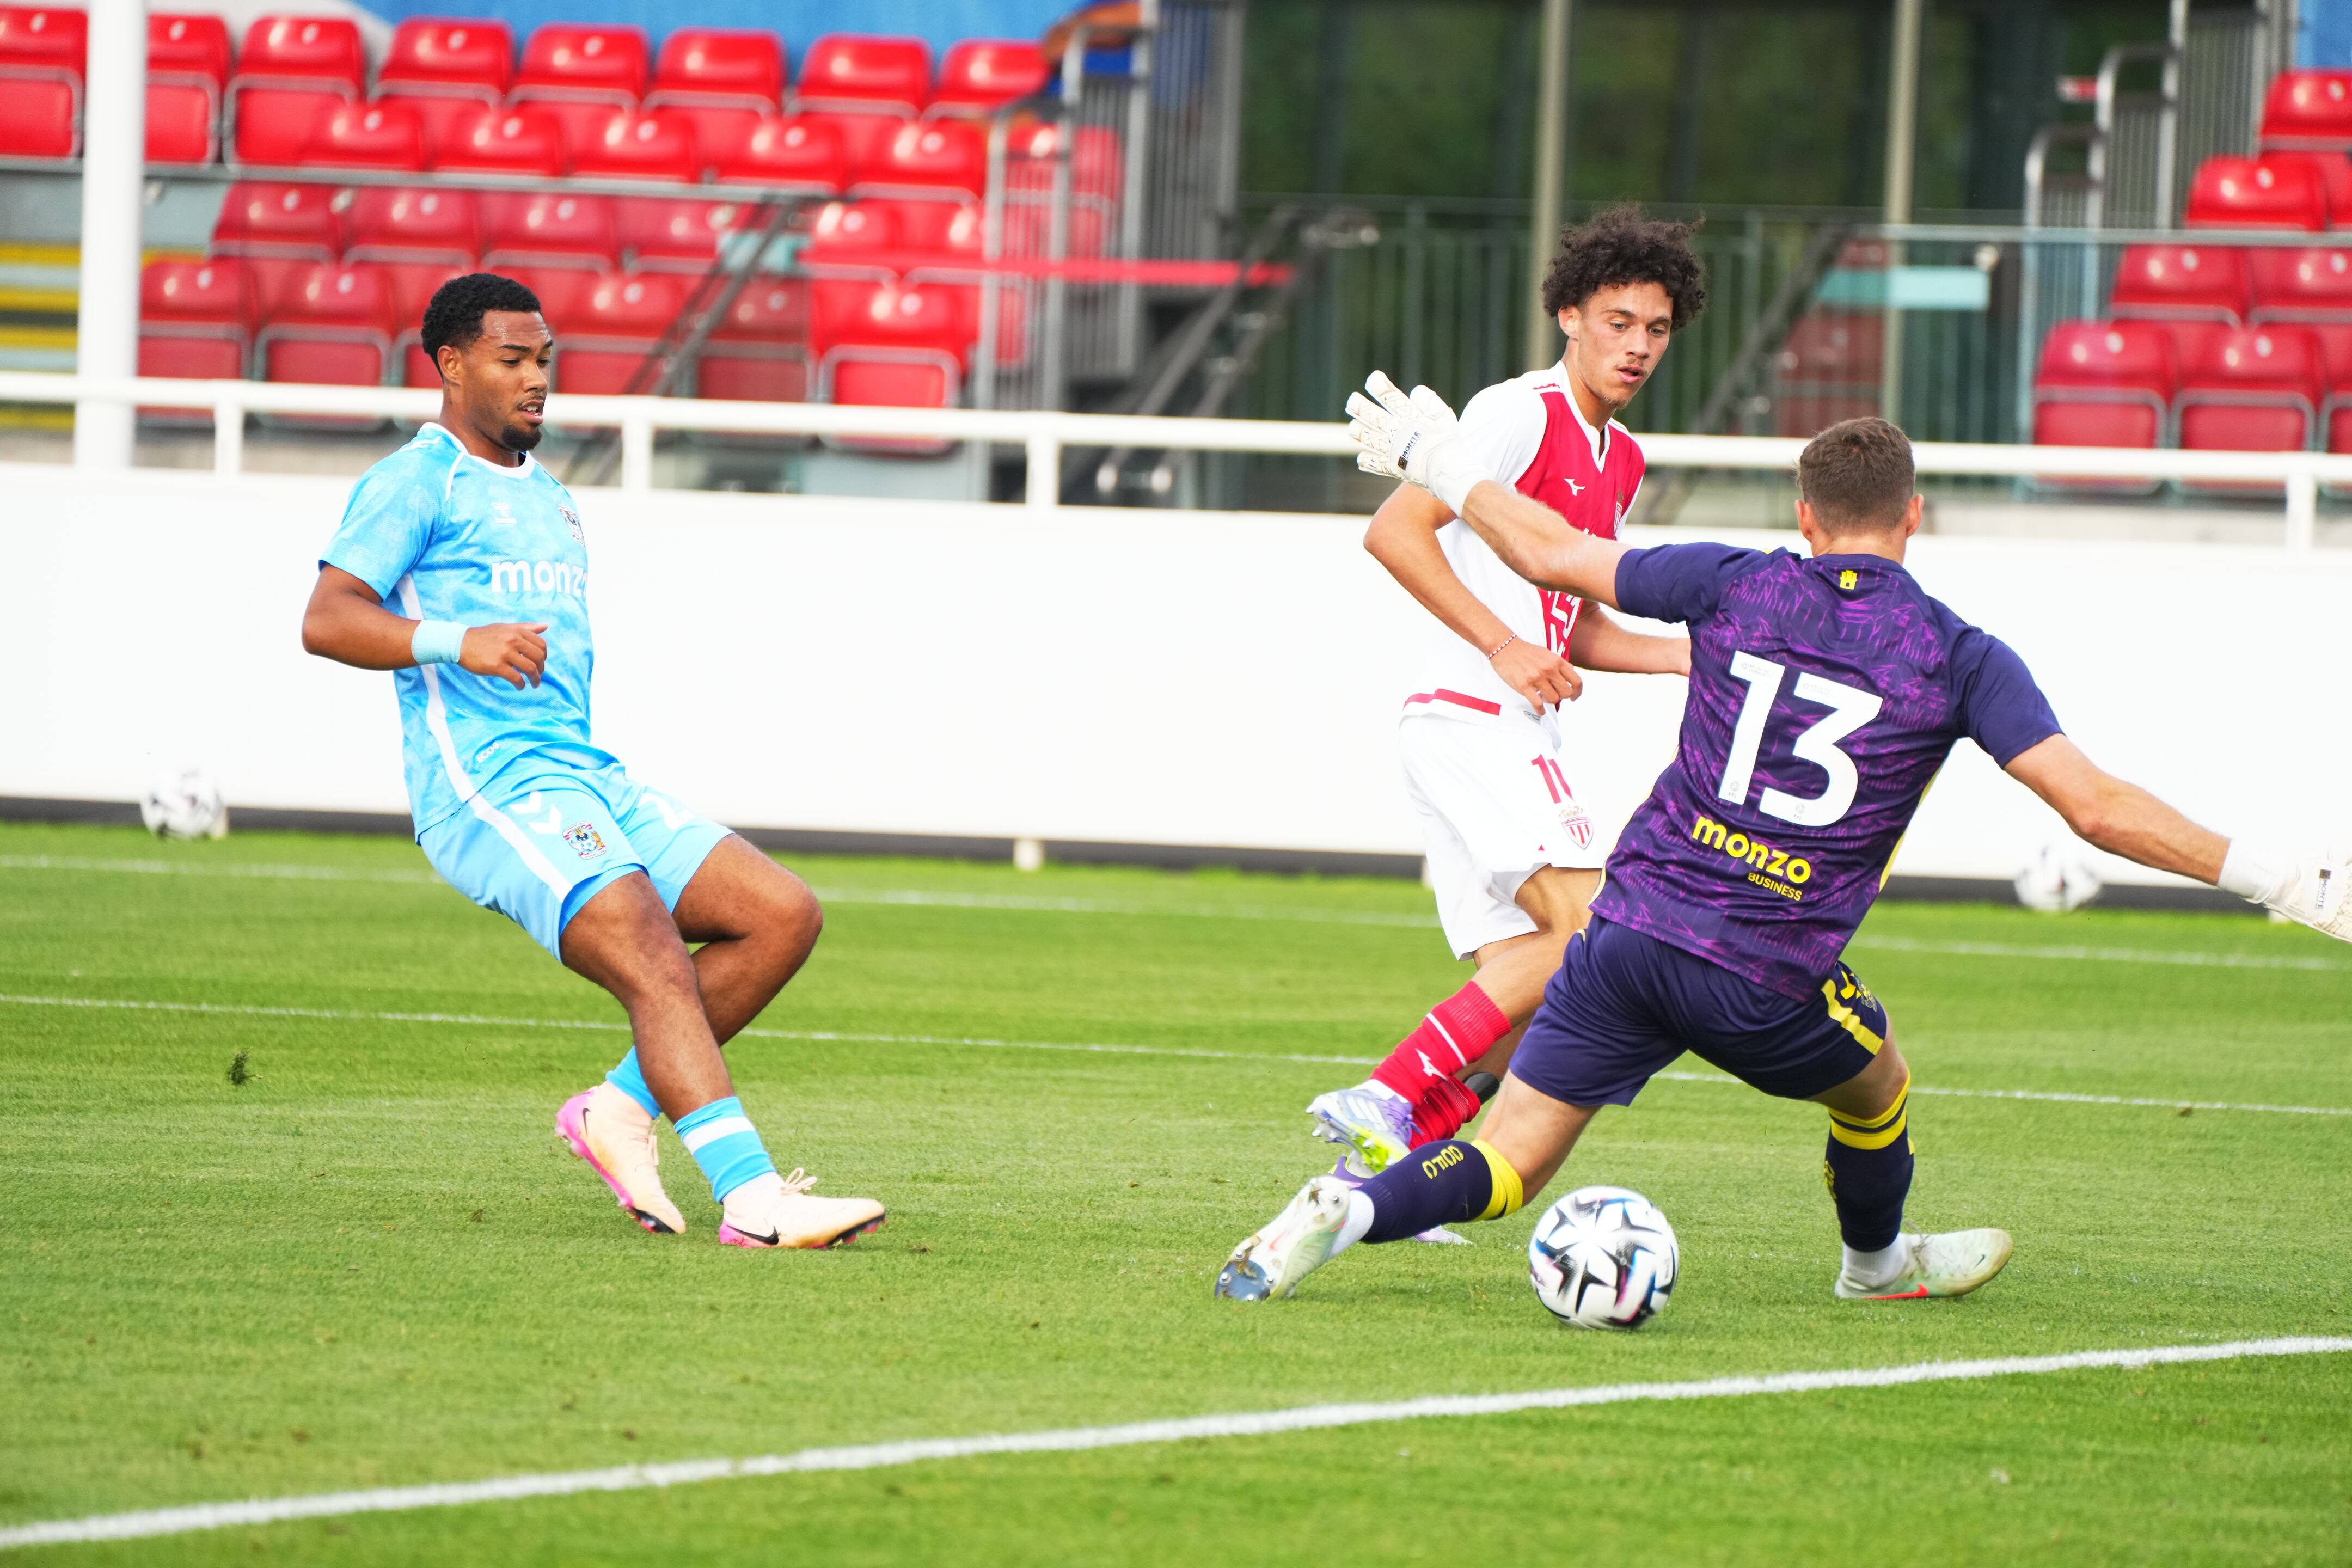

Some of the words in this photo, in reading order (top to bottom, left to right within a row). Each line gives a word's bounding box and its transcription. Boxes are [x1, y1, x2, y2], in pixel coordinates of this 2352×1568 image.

[1718, 651, 1883, 826] 13
[1692, 816, 1811, 884] monzo
[1748, 872, 1803, 901] BUSINESS
